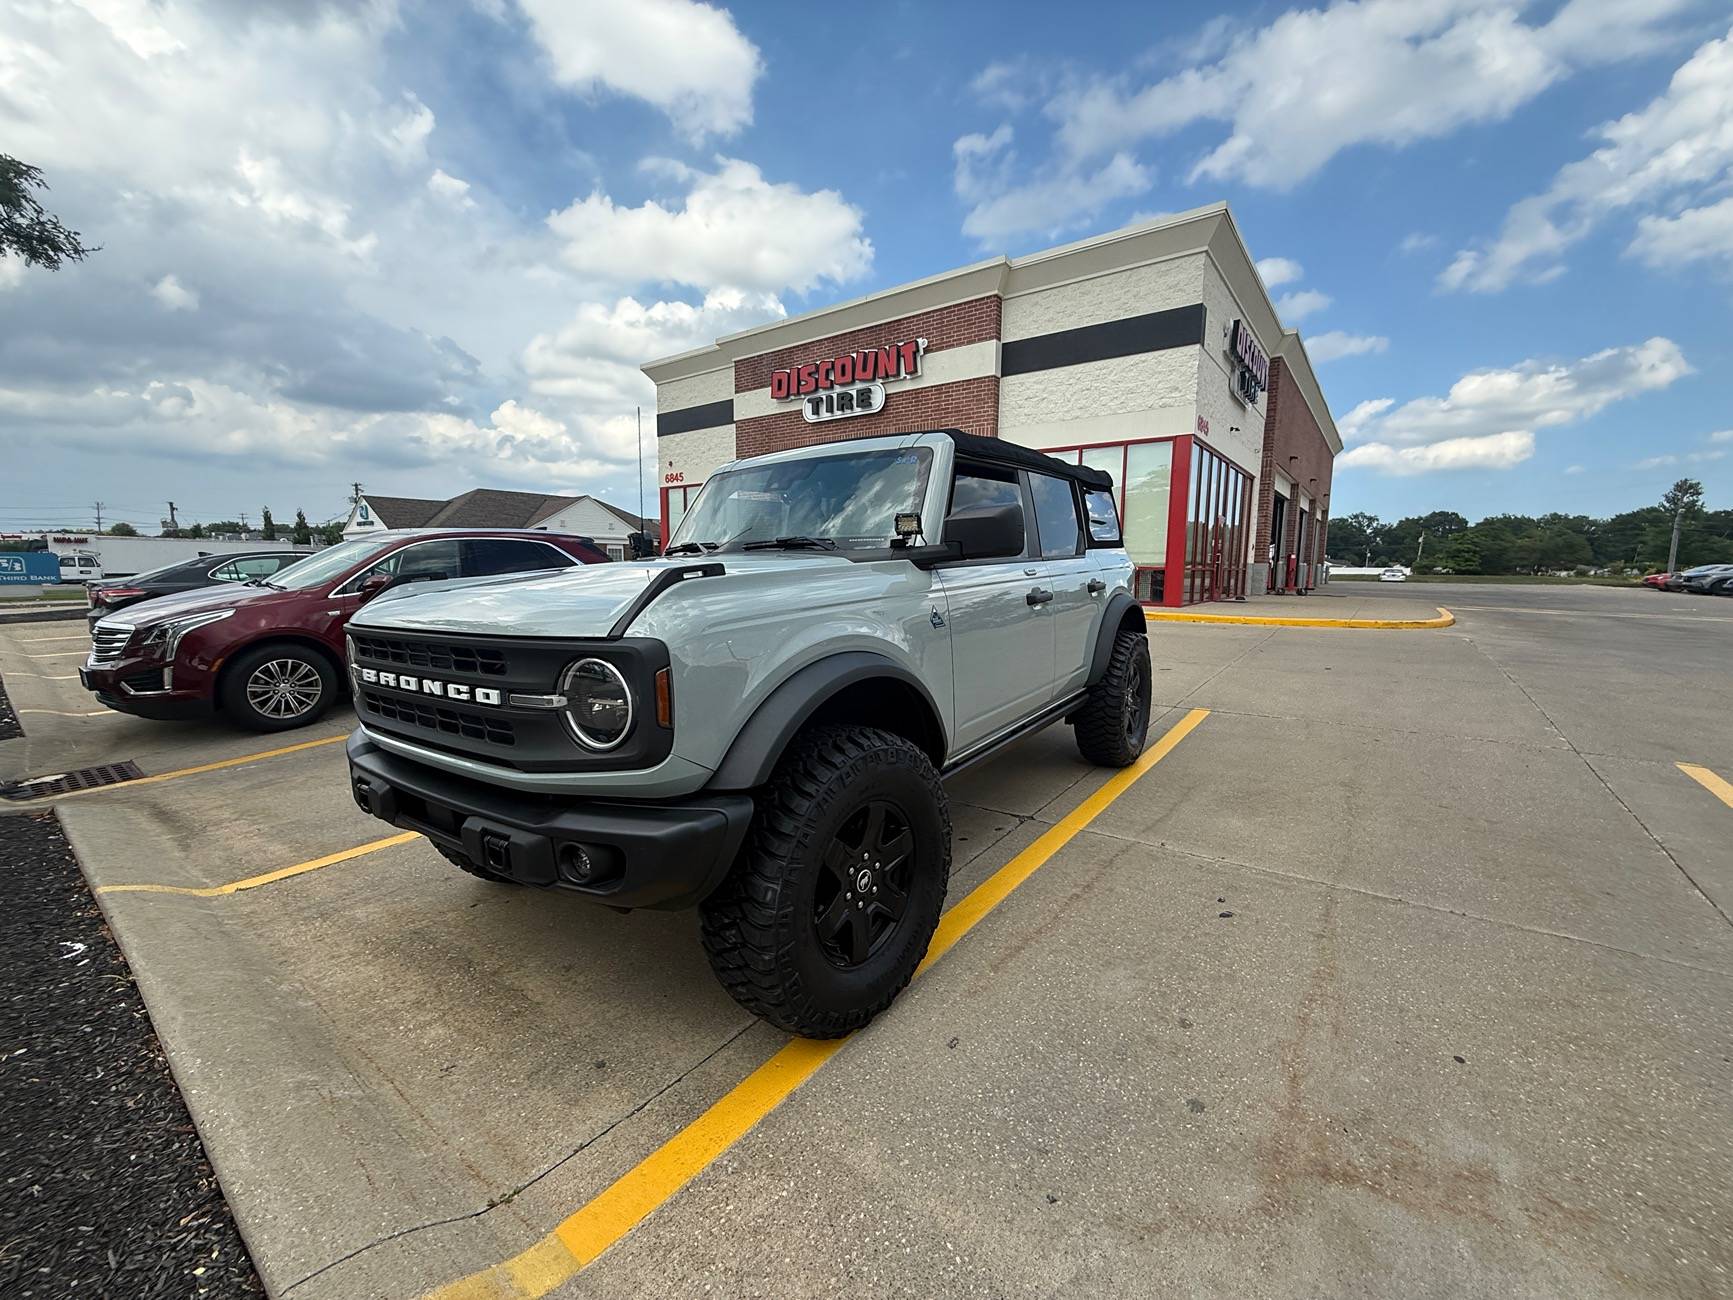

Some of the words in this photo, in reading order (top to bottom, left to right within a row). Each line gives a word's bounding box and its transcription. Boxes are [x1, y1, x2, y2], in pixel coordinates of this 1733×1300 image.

[771, 339, 919, 400] DISCOUNT
[807, 387, 873, 416] TIRE
[664, 472, 684, 484] 6845
[362, 668, 501, 705] BRONCO
